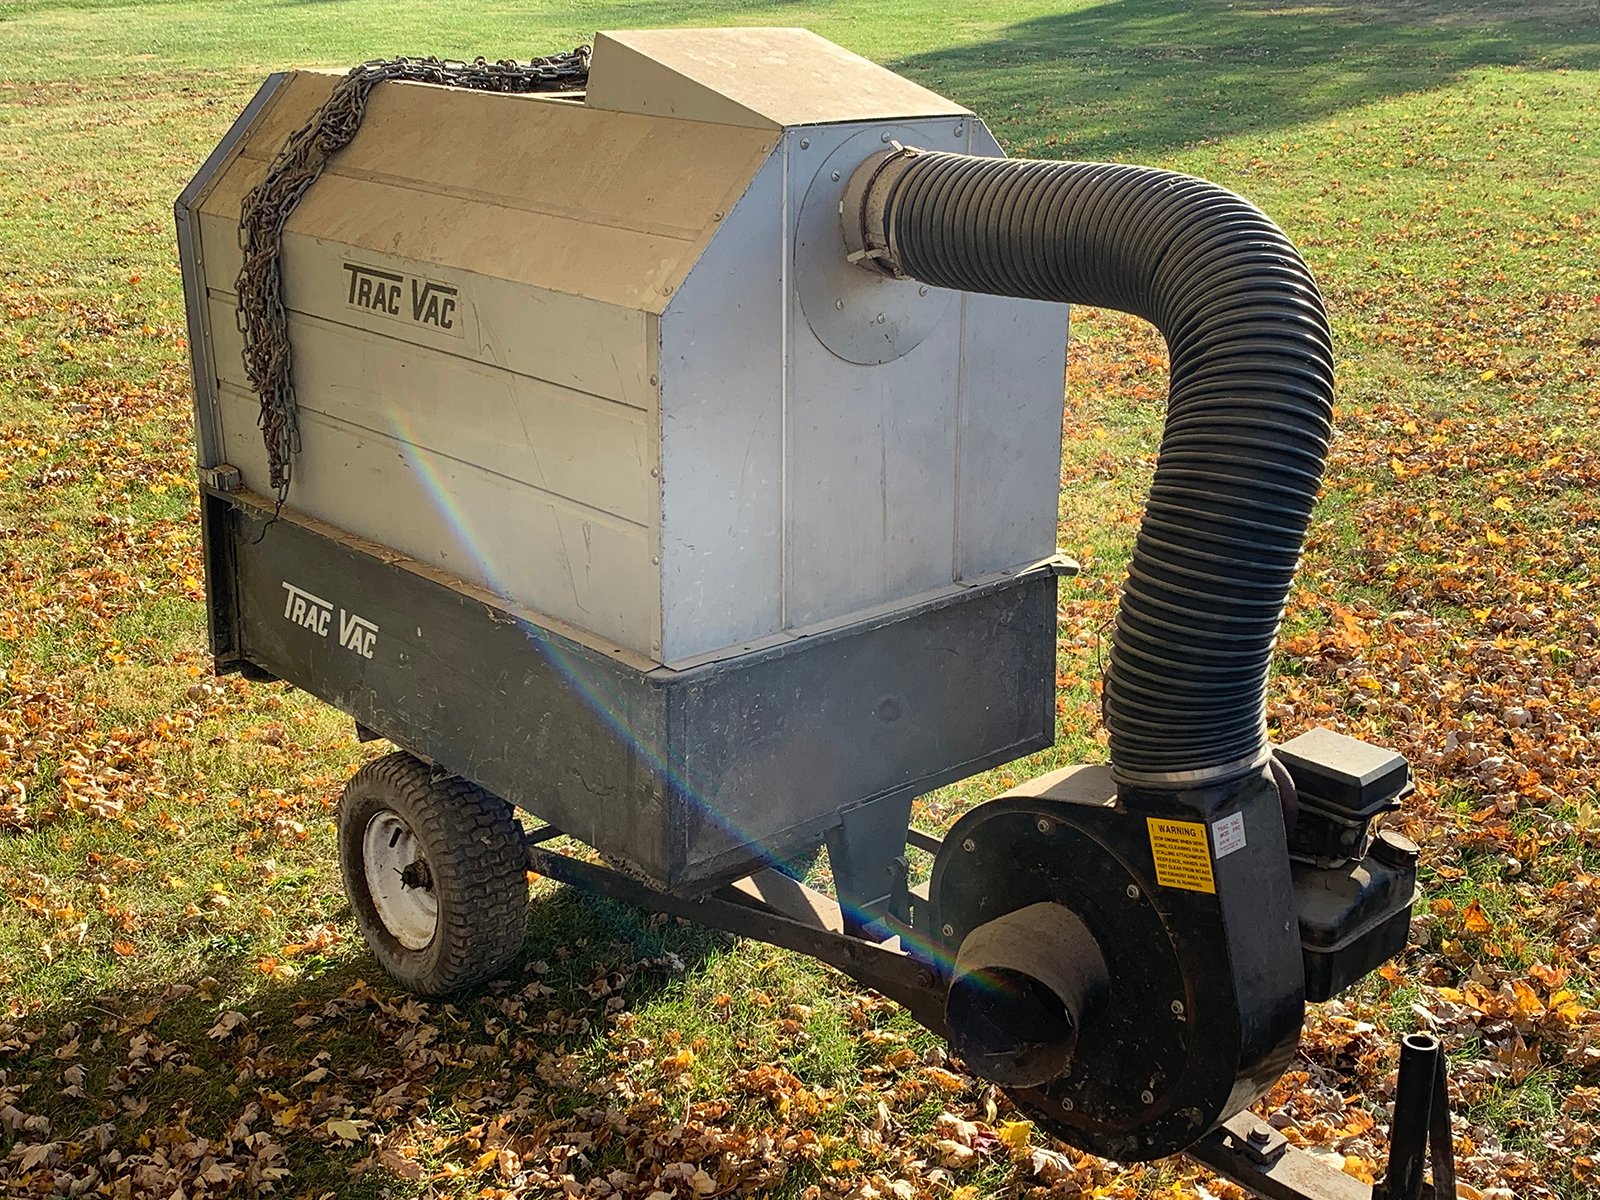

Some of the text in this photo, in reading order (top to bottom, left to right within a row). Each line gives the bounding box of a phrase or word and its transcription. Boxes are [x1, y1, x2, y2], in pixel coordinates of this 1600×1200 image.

[343, 263, 458, 329] TRAC VAC
[282, 581, 379, 659] TRAC VAC
[1158, 824, 1196, 837] WARNING
